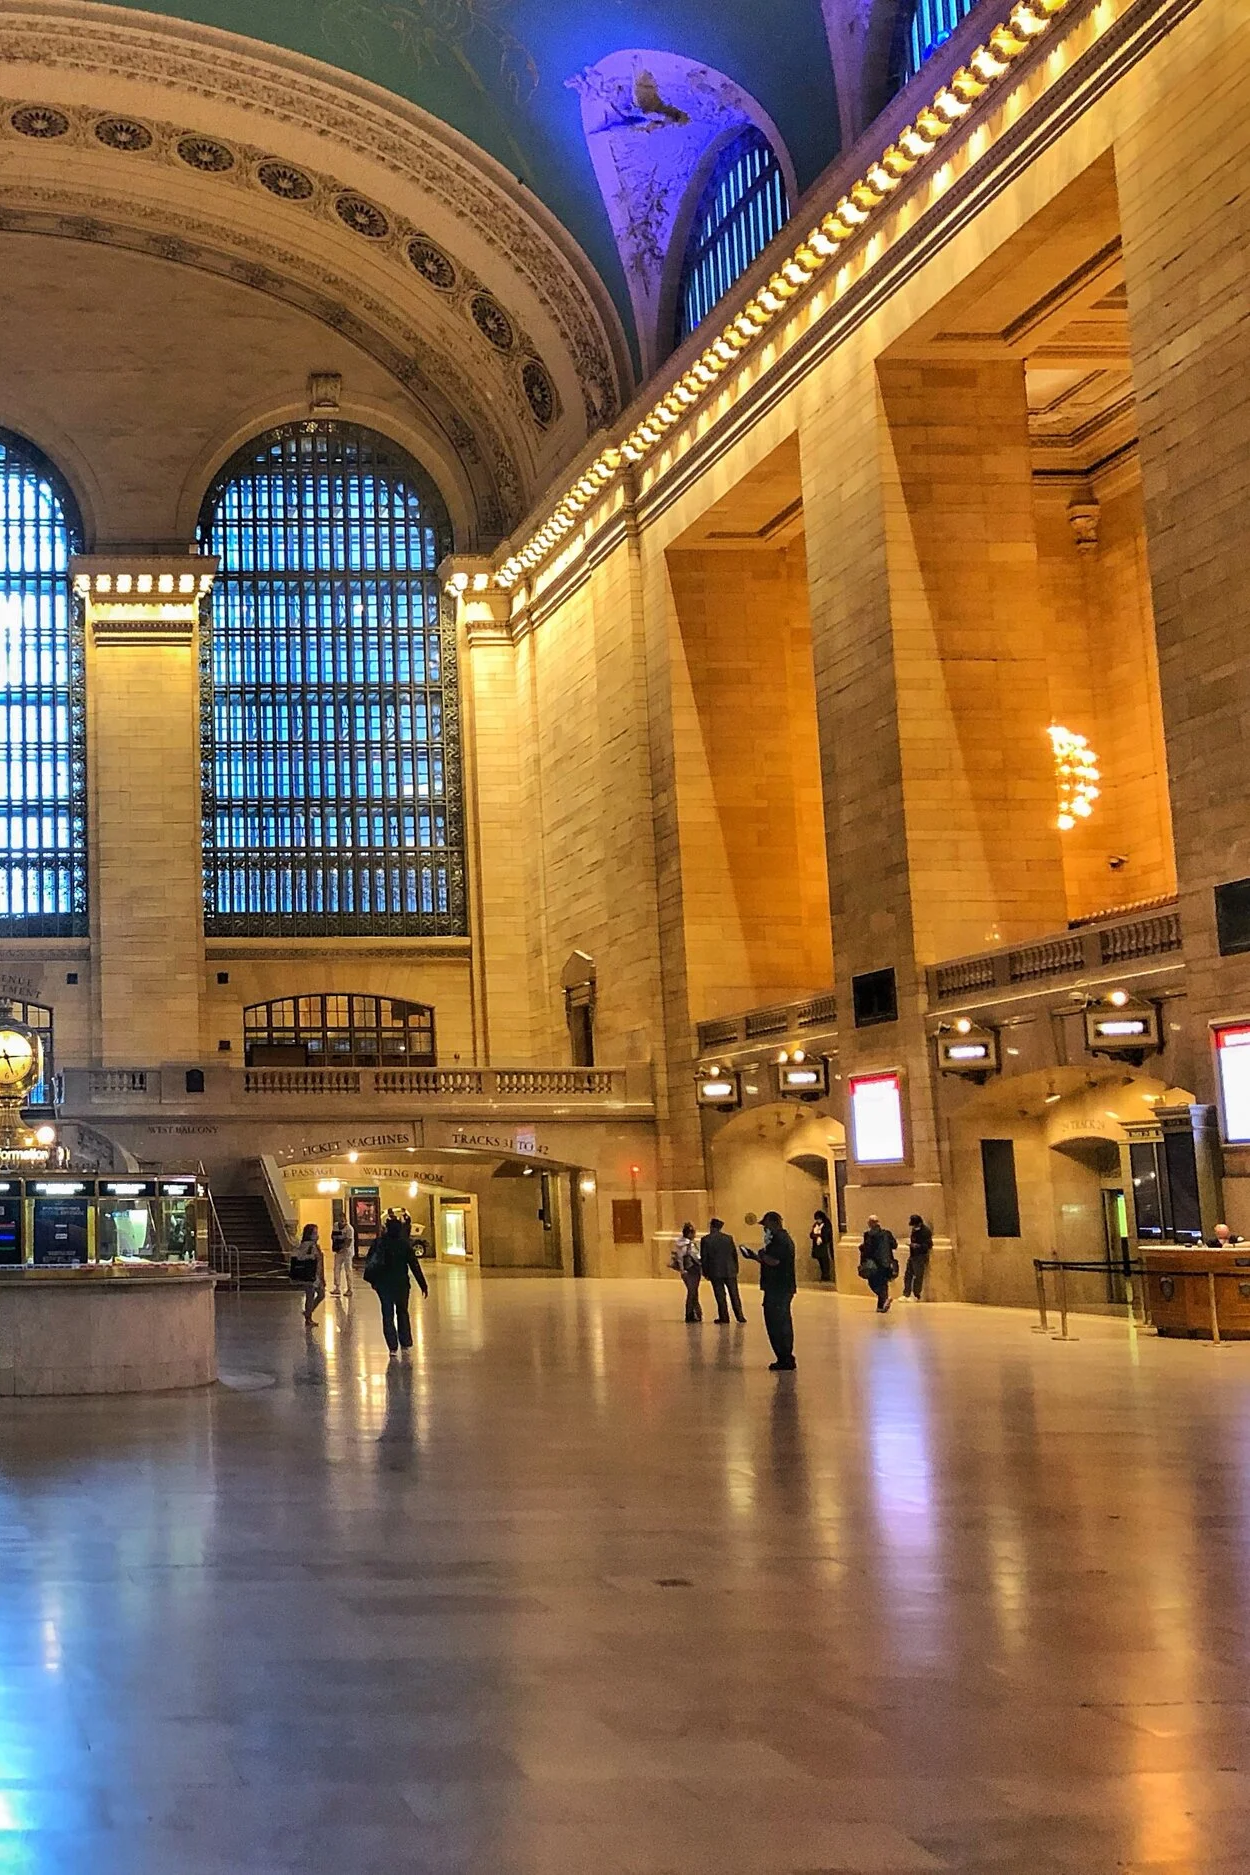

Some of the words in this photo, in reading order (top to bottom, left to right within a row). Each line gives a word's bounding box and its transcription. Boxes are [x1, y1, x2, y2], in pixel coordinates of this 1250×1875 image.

[148, 1126, 173, 1134] WEST
[175, 1126, 219, 1135] BALCONY
[301, 1140, 342, 1157] TICKET
[346, 1133, 410, 1148] MACHINES
[452, 1133, 500, 1147] TRACKS
[503, 1138, 513, 1149] 31
[517, 1141, 534, 1151] TO
[537, 1145, 549, 1155] 42
[292, 1166, 335, 1177] PASSAGE
[362, 1167, 409, 1178] WAITING
[414, 1171, 445, 1183] ROOM
